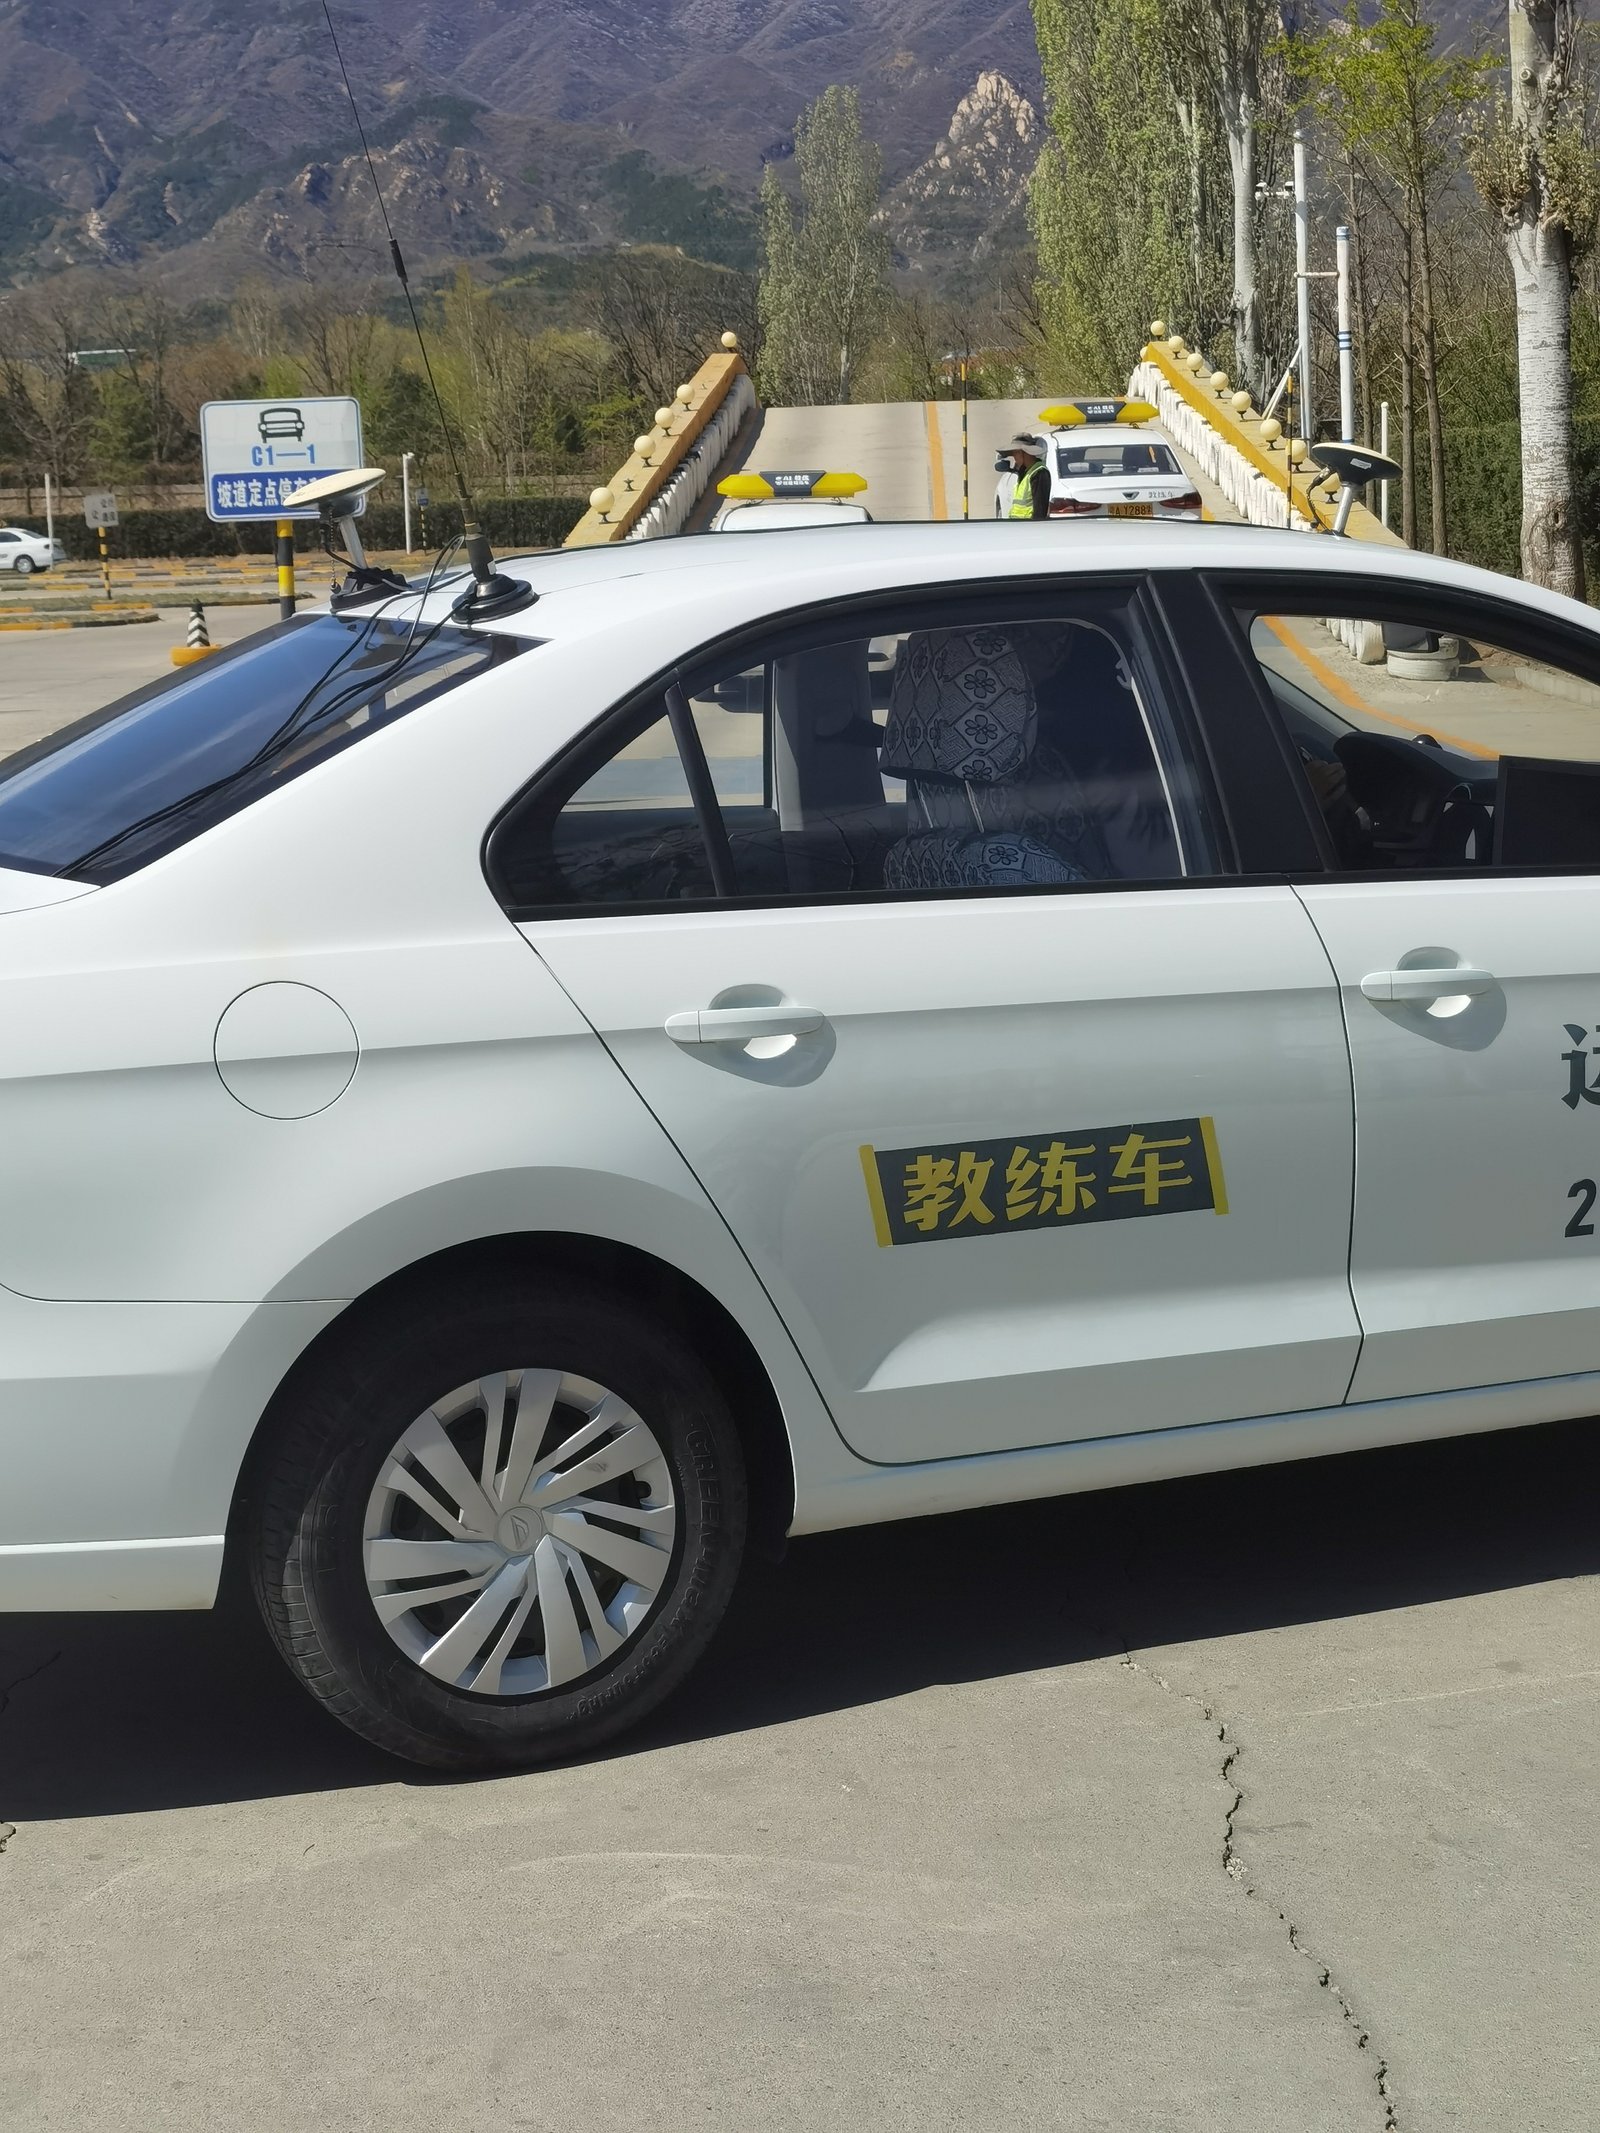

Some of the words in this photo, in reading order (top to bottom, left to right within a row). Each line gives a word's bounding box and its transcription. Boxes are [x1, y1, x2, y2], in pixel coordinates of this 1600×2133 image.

[217, 476, 318, 508] 坡道定点停
[902, 1132, 1193, 1232] 教练车
[1564, 1178, 1597, 1238] 2
